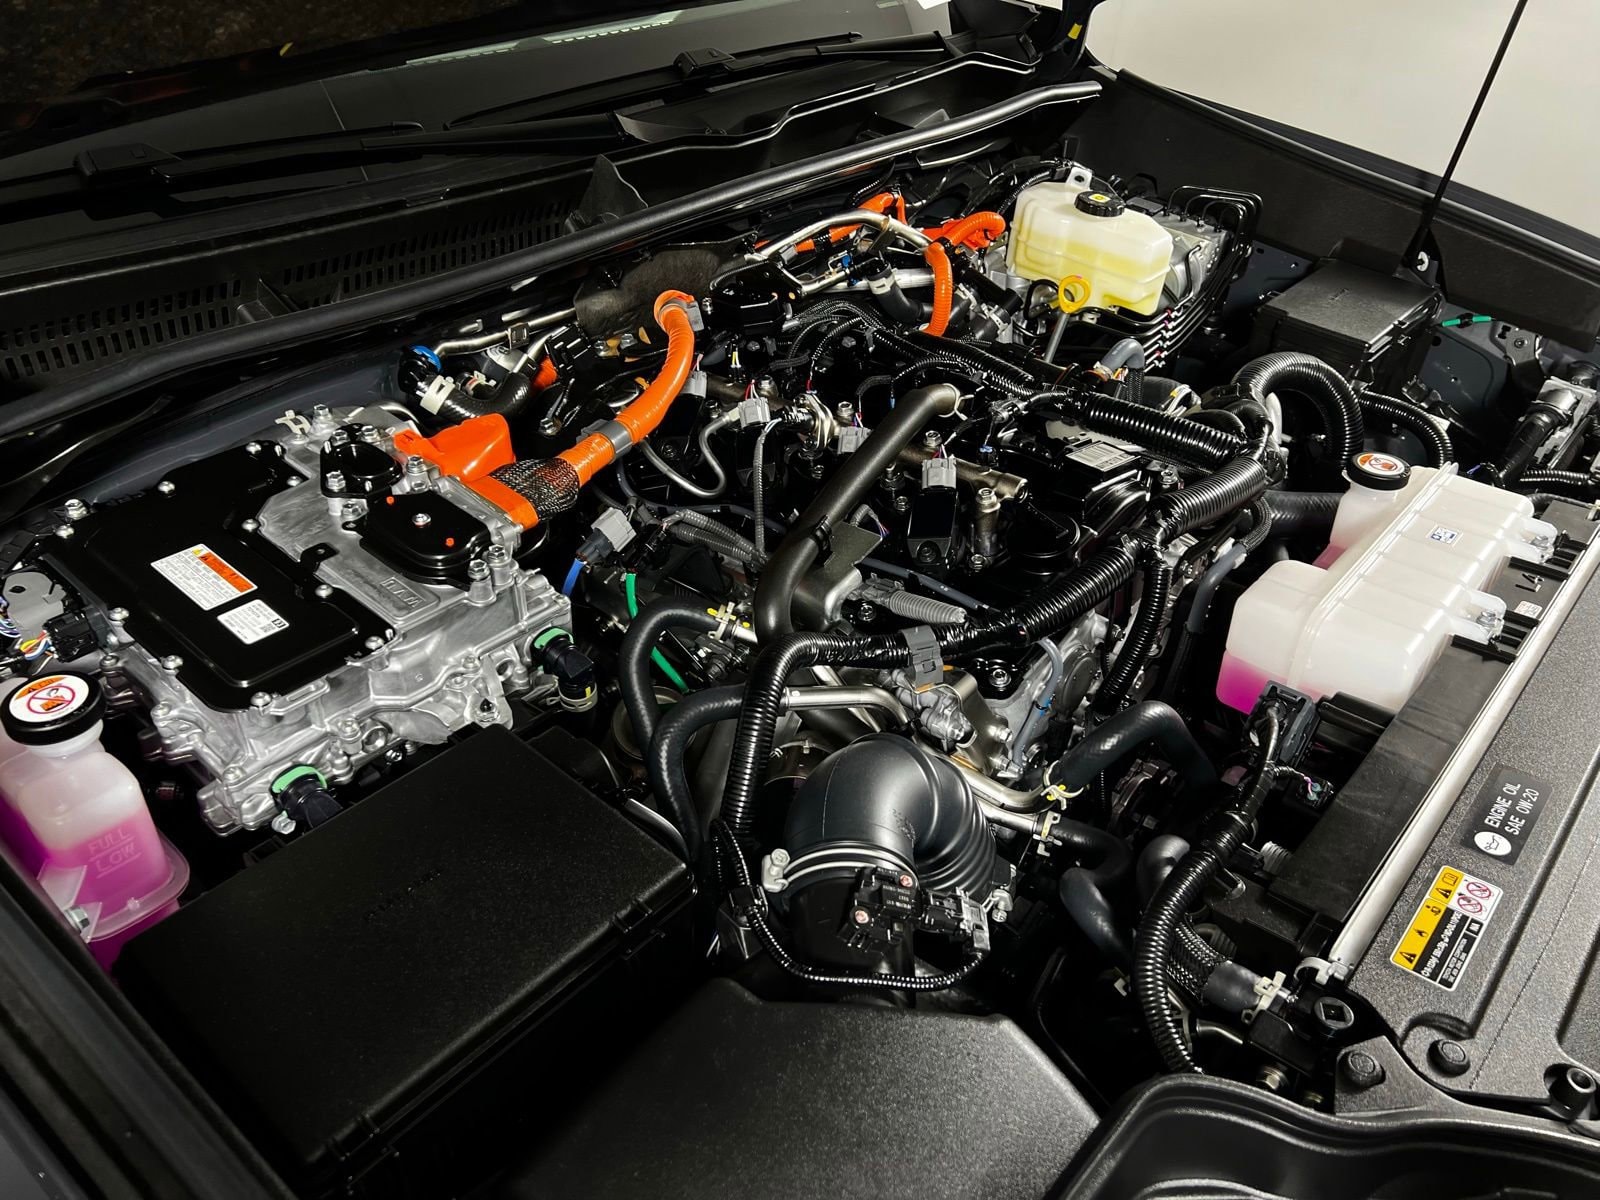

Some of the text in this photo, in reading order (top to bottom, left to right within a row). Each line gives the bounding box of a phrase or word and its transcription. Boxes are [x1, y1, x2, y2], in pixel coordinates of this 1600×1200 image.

[1484, 783, 1521, 828] ENGINE OIL
[1504, 788, 1539, 836] SAE 0W-20
[88, 828, 131, 856] FULL
[96, 842, 136, 872] LOW
